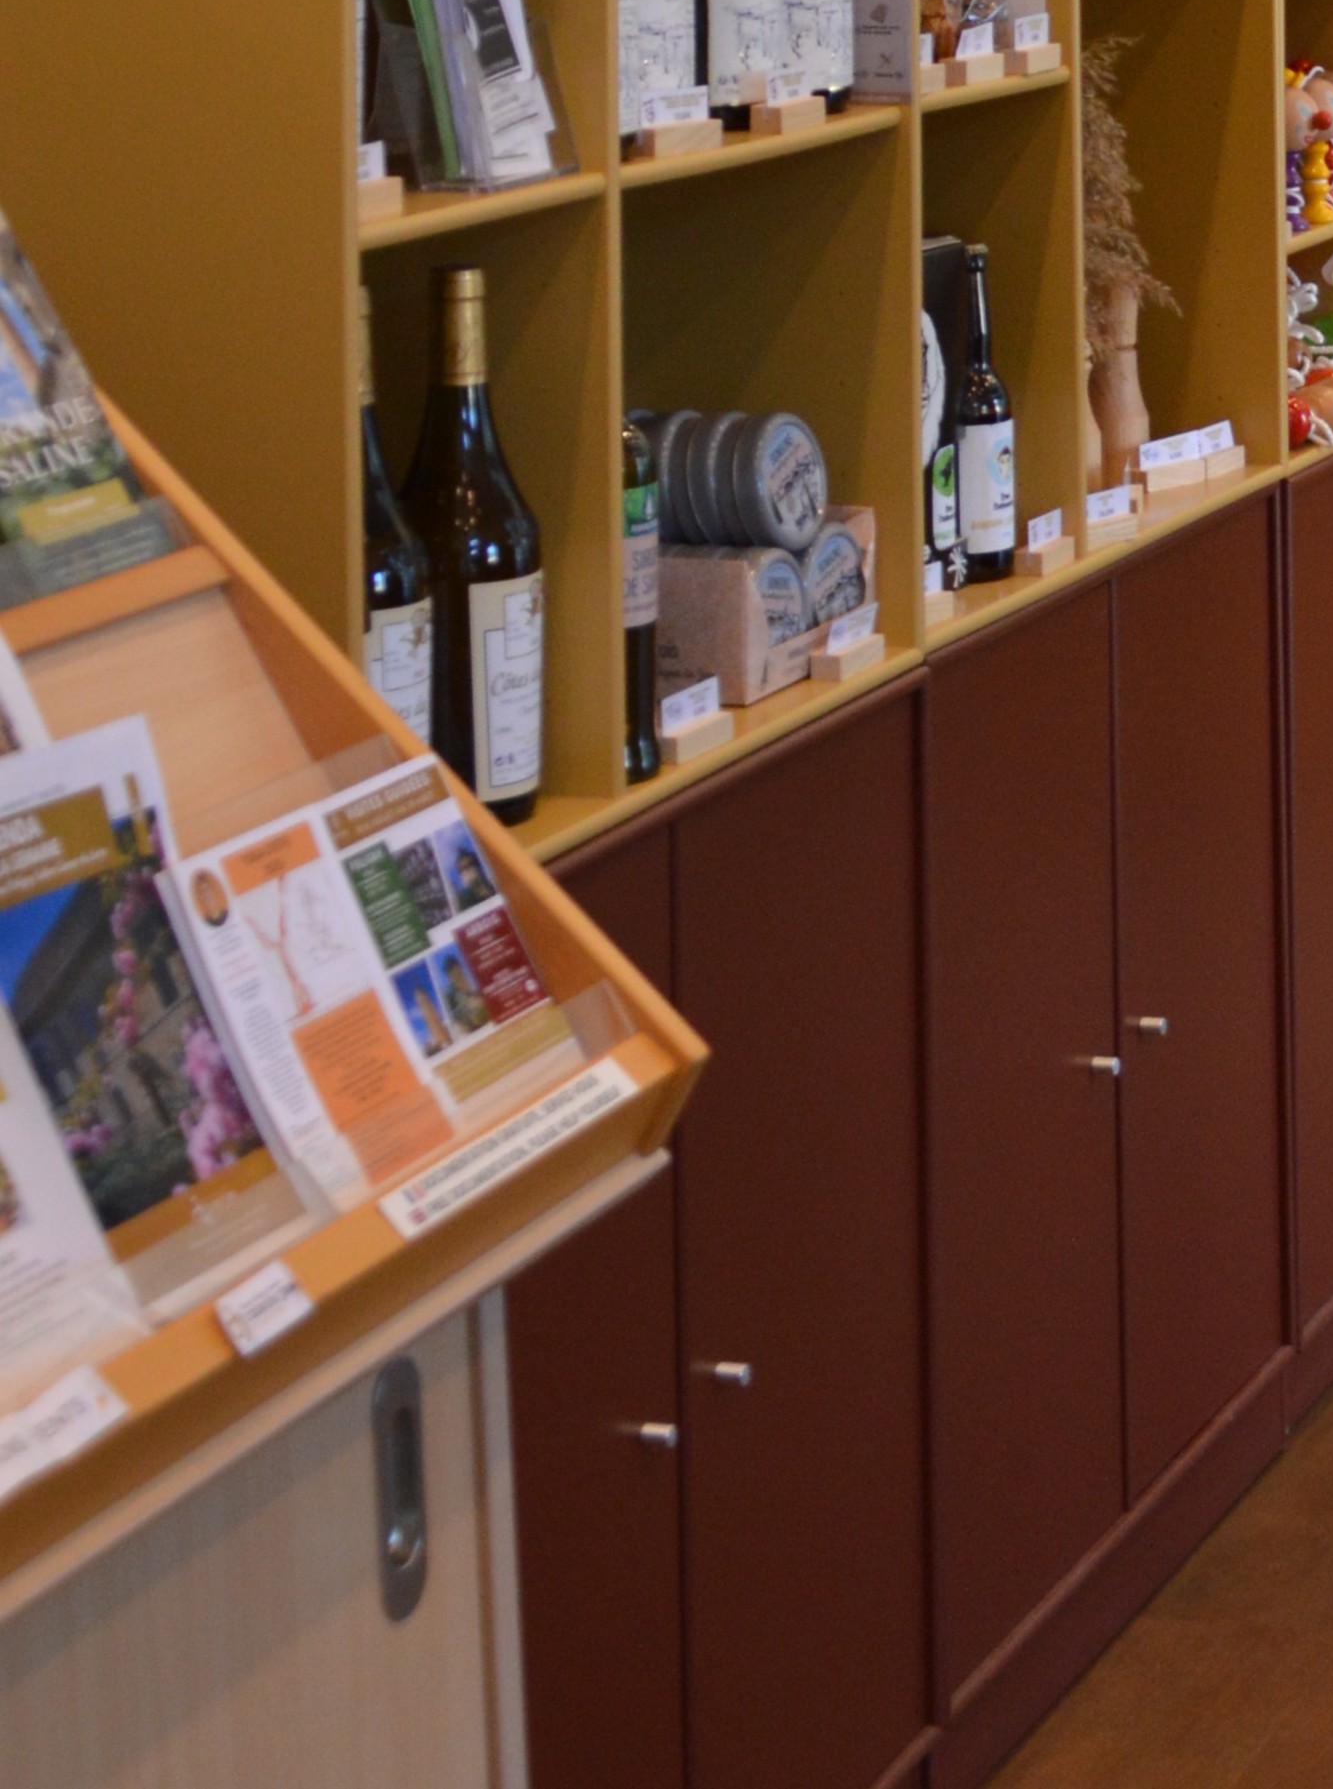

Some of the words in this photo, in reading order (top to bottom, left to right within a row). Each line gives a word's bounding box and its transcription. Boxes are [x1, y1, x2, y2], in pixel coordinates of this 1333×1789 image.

[420, 1137, 499, 1190] DOCUMENTATION
[425, 1194, 451, 1214] FREE
[527, 1124, 559, 1150] PLEASE
[558, 1112, 579, 1130] HELP
[578, 1084, 621, 1116] YOURSELF
